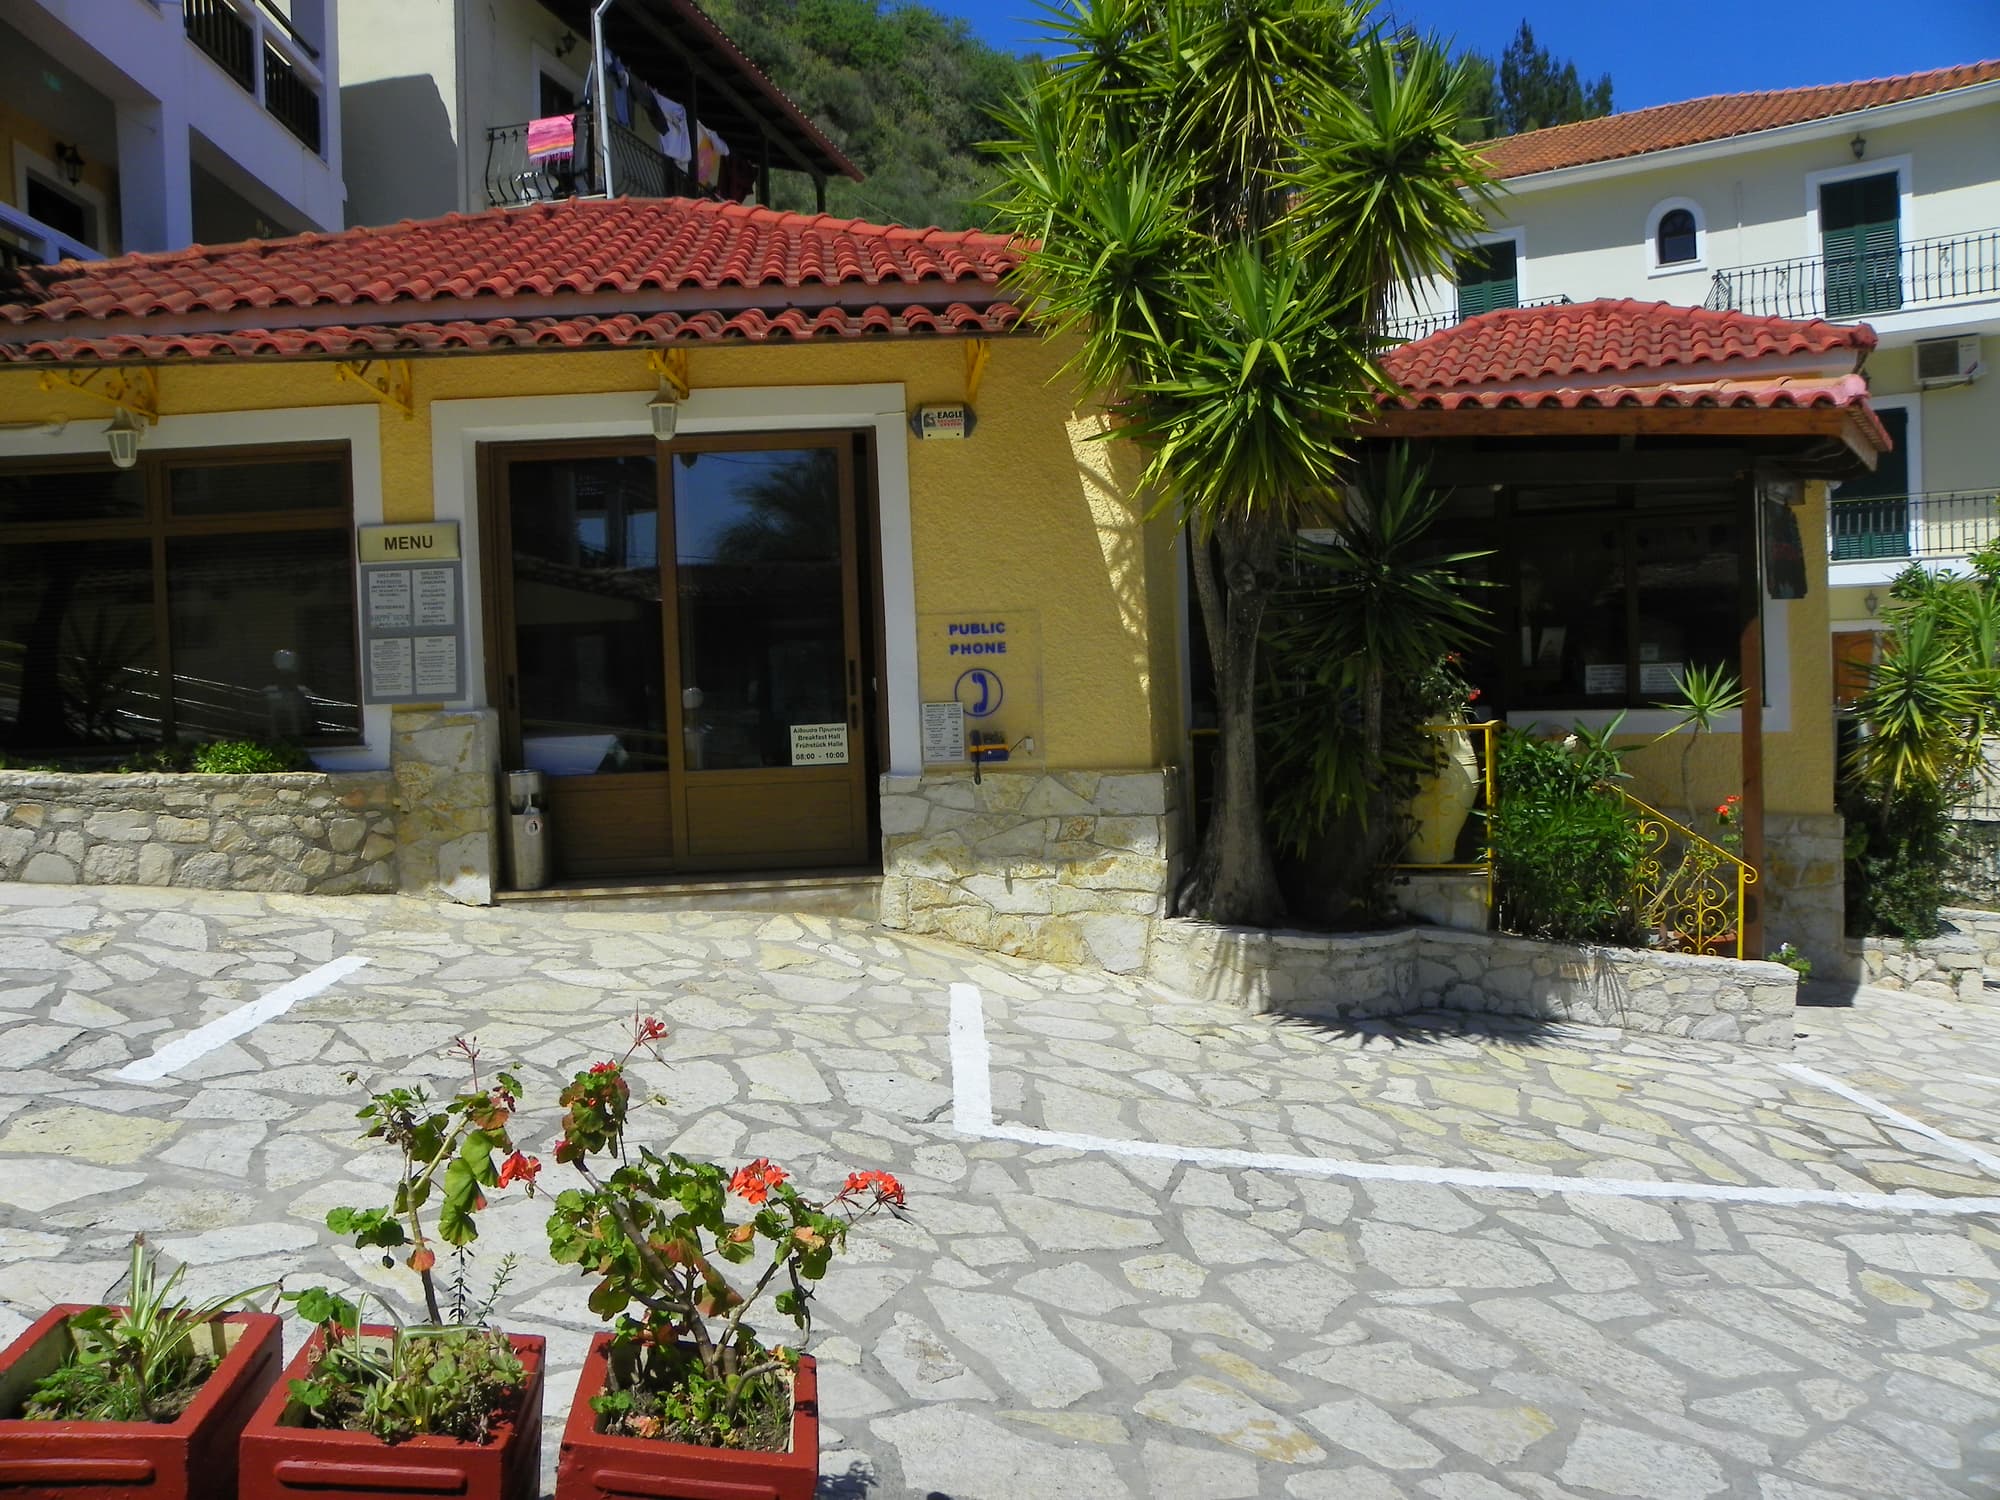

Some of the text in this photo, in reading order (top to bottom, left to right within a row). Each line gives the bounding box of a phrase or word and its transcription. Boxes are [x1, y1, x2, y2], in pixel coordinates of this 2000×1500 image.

[384, 535, 433, 550] MENU
[949, 622, 1006, 635] PUBLIC
[950, 642, 1007, 655] PHONE
